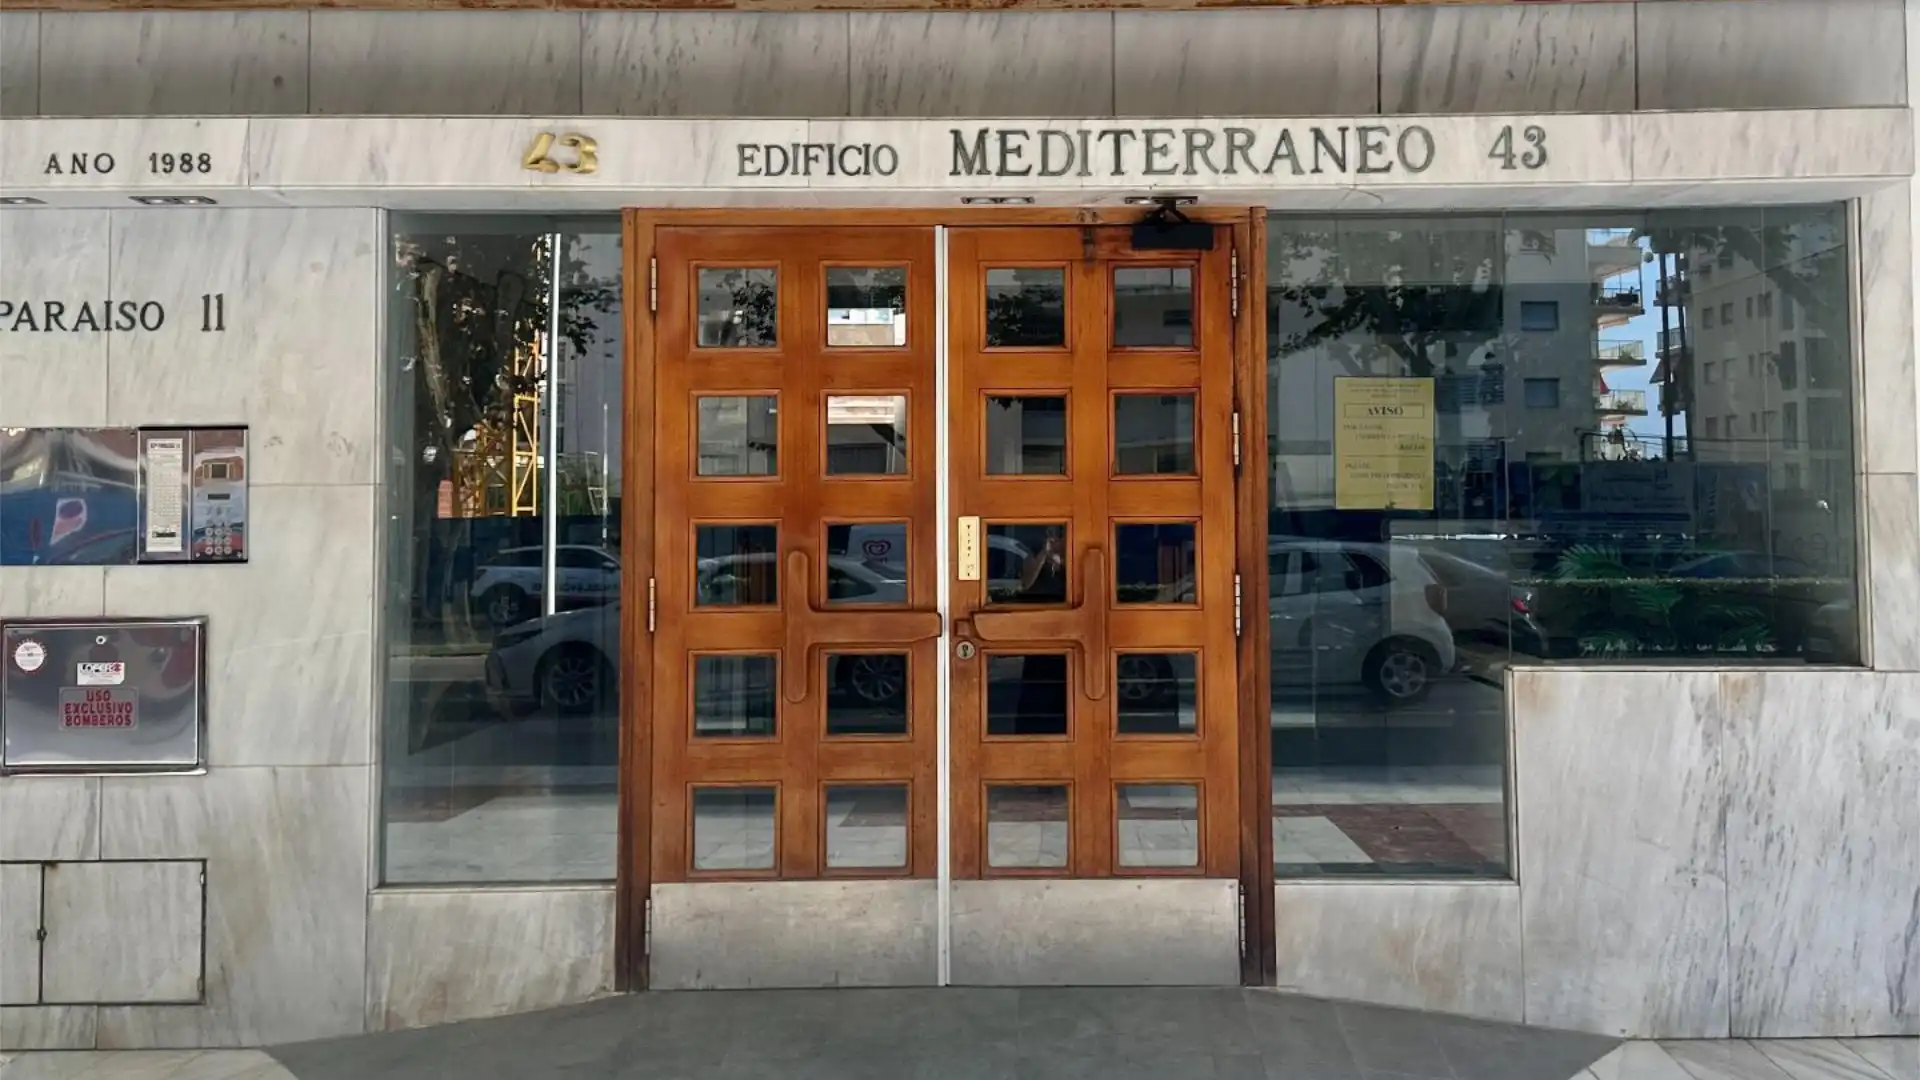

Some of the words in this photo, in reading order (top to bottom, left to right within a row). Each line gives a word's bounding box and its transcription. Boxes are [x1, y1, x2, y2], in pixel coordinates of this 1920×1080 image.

[522, 131, 598, 174] 43
[736, 143, 899, 177] EDIFICIO
[949, 126, 1435, 178] MEDITERRANEO
[1488, 125, 1548, 169] 43
[43, 152, 116, 175] ANO
[148, 152, 213, 174] 1988
[0, 300, 165, 332] PARAISO
[200, 293, 226, 332] 11
[1367, 405, 1404, 416] AVISO
[86, 690, 111, 702] USO
[65, 702, 133, 714] EXCLUSIVO
[65, 714, 132, 726] BOMBEROS
